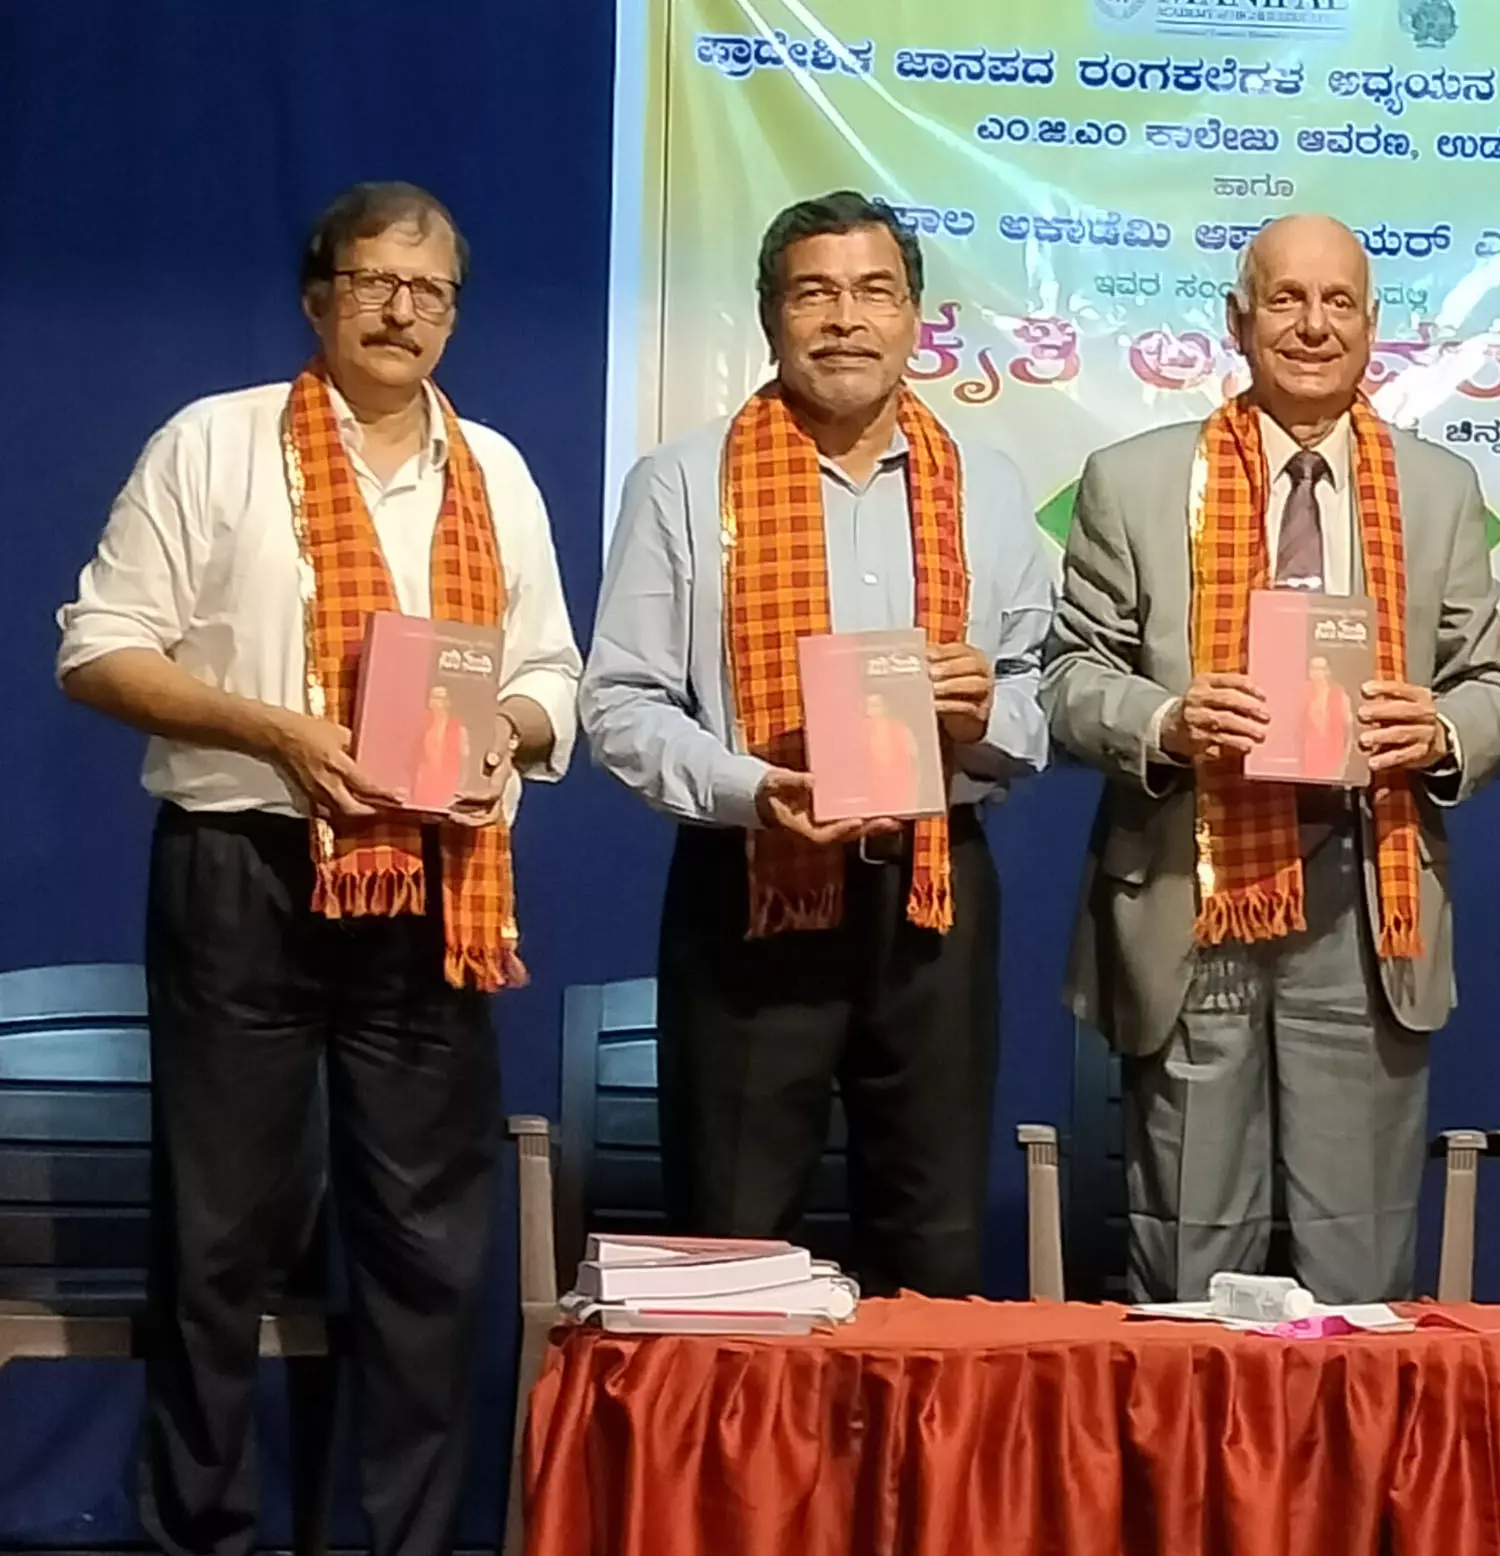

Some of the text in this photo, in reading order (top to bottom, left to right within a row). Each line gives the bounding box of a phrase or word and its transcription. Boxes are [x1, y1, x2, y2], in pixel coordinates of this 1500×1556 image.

[896, 46, 1054, 86] ಜಾನಪದ
[1079, 54, 1304, 95] ರಂಗಕಲೆಗಳ
[1328, 65, 1496, 115] ಅಧ್ಯಯನ
[1145, 118, 1279, 151] ಕಾಲೇಜು
[1213, 173, 1294, 197] ಹಾಗೂ
[1095, 271, 1161, 299] ಇವರ
